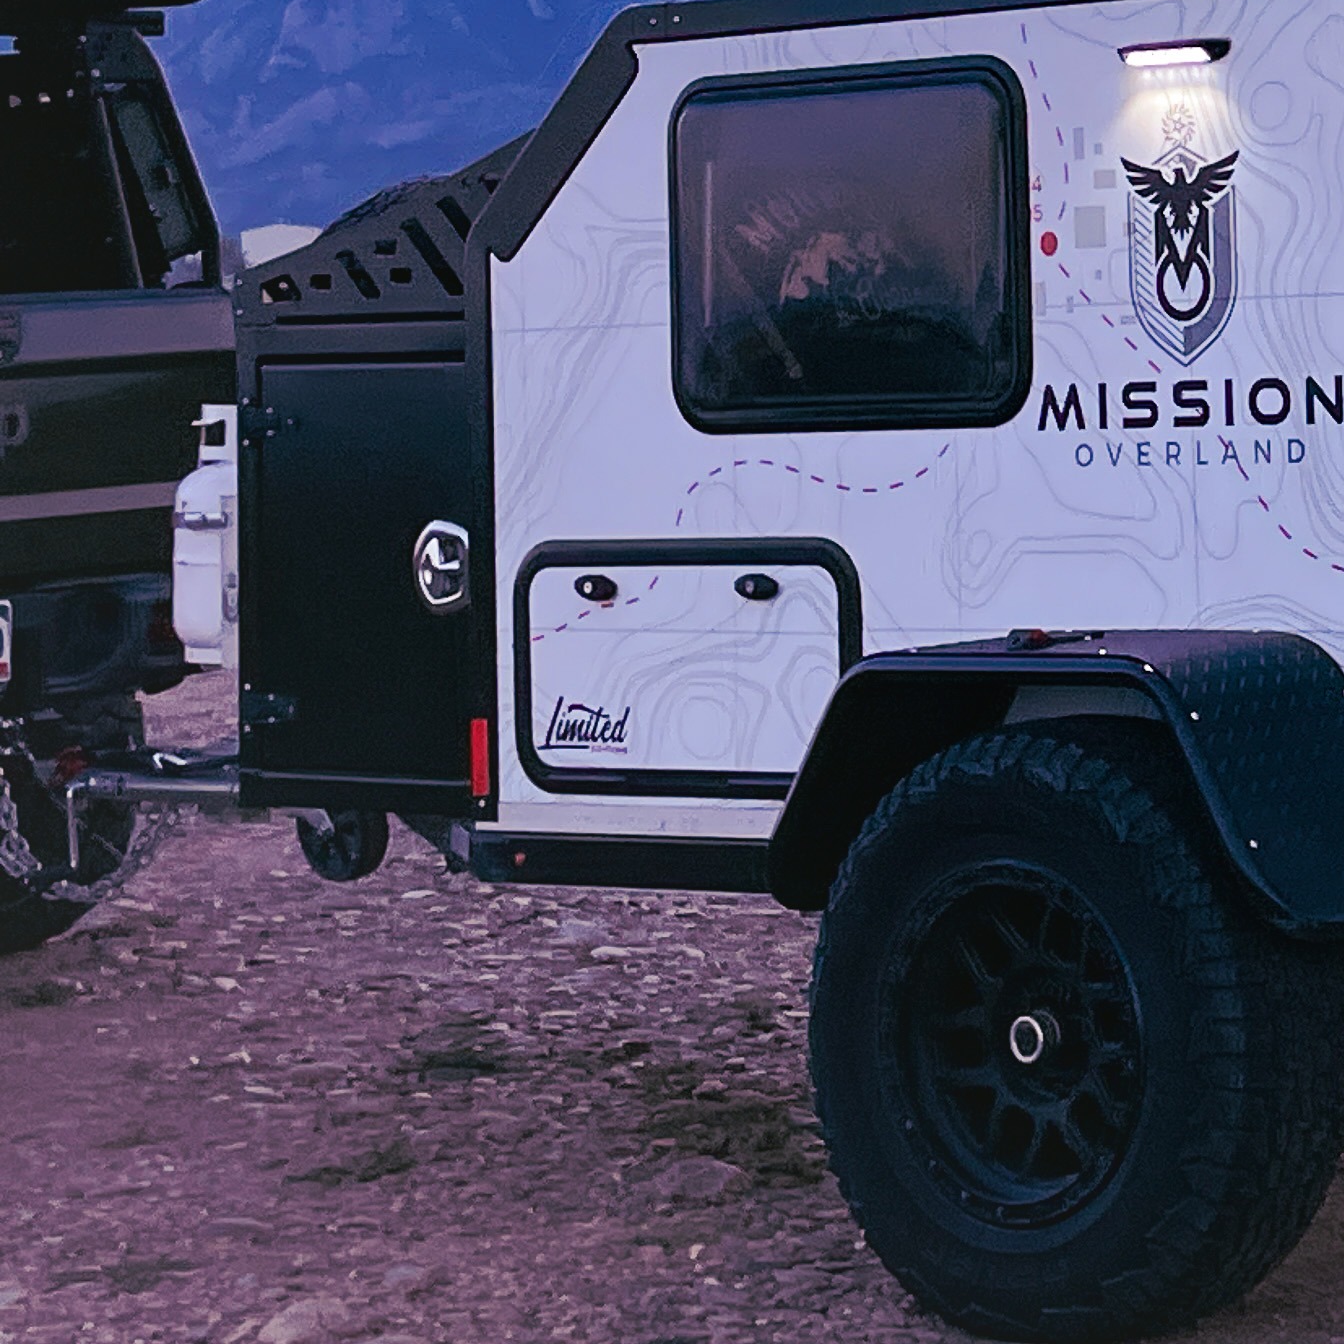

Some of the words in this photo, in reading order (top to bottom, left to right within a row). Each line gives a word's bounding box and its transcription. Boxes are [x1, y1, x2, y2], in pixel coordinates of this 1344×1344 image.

[1037, 374, 1344, 432] MISSION
[1075, 438, 1306, 468] OVERLAND
[537, 696, 630, 750] Limited
